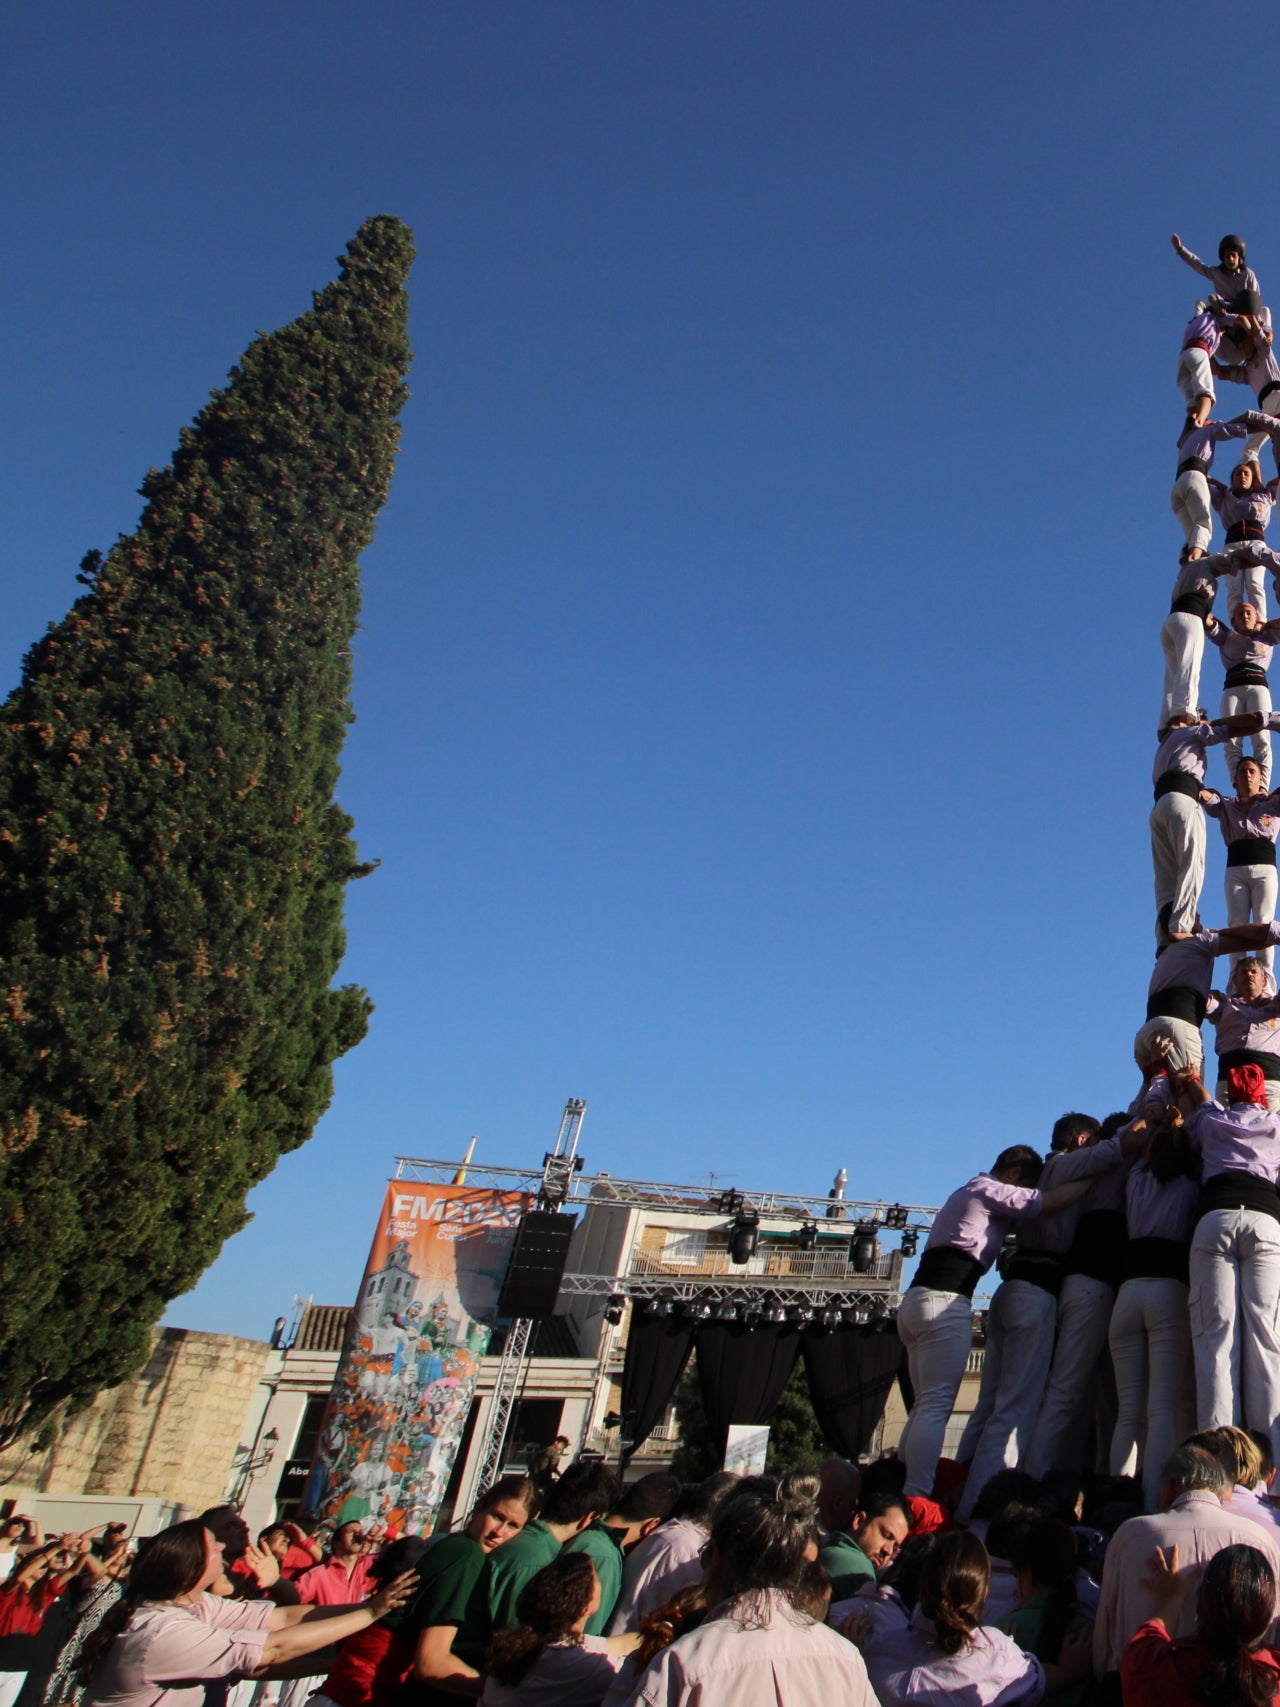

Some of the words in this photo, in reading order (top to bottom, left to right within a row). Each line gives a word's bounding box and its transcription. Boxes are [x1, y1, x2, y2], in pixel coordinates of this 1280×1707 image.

[388, 1219, 417, 1229] Festa
[438, 1223, 464, 1233] Sant
[385, 1228, 418, 1239] Major
